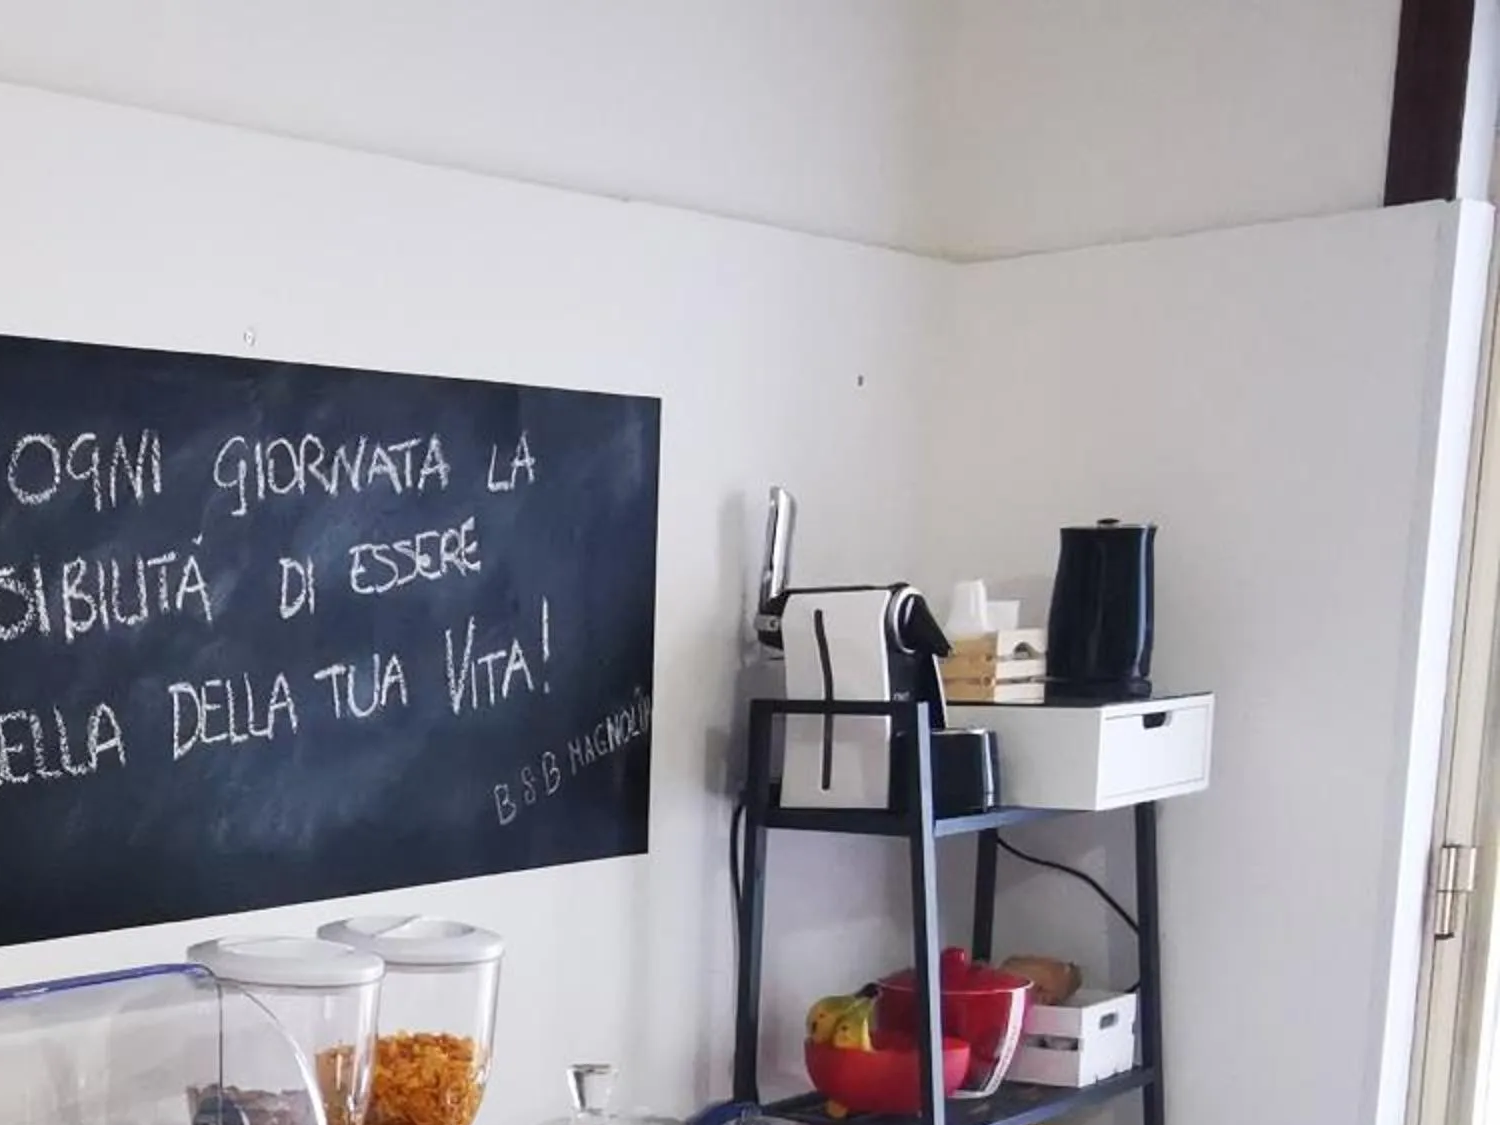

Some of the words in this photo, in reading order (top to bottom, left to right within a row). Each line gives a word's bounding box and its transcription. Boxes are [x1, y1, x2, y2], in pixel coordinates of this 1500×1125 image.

[213, 433, 451, 516] GIORNATA
[486, 430, 536, 493] LA
[278, 555, 315, 619] DI
[349, 516, 482, 595] ESSERE
[168, 673, 298, 761] DELLA
[314, 653, 409, 719] TUA
